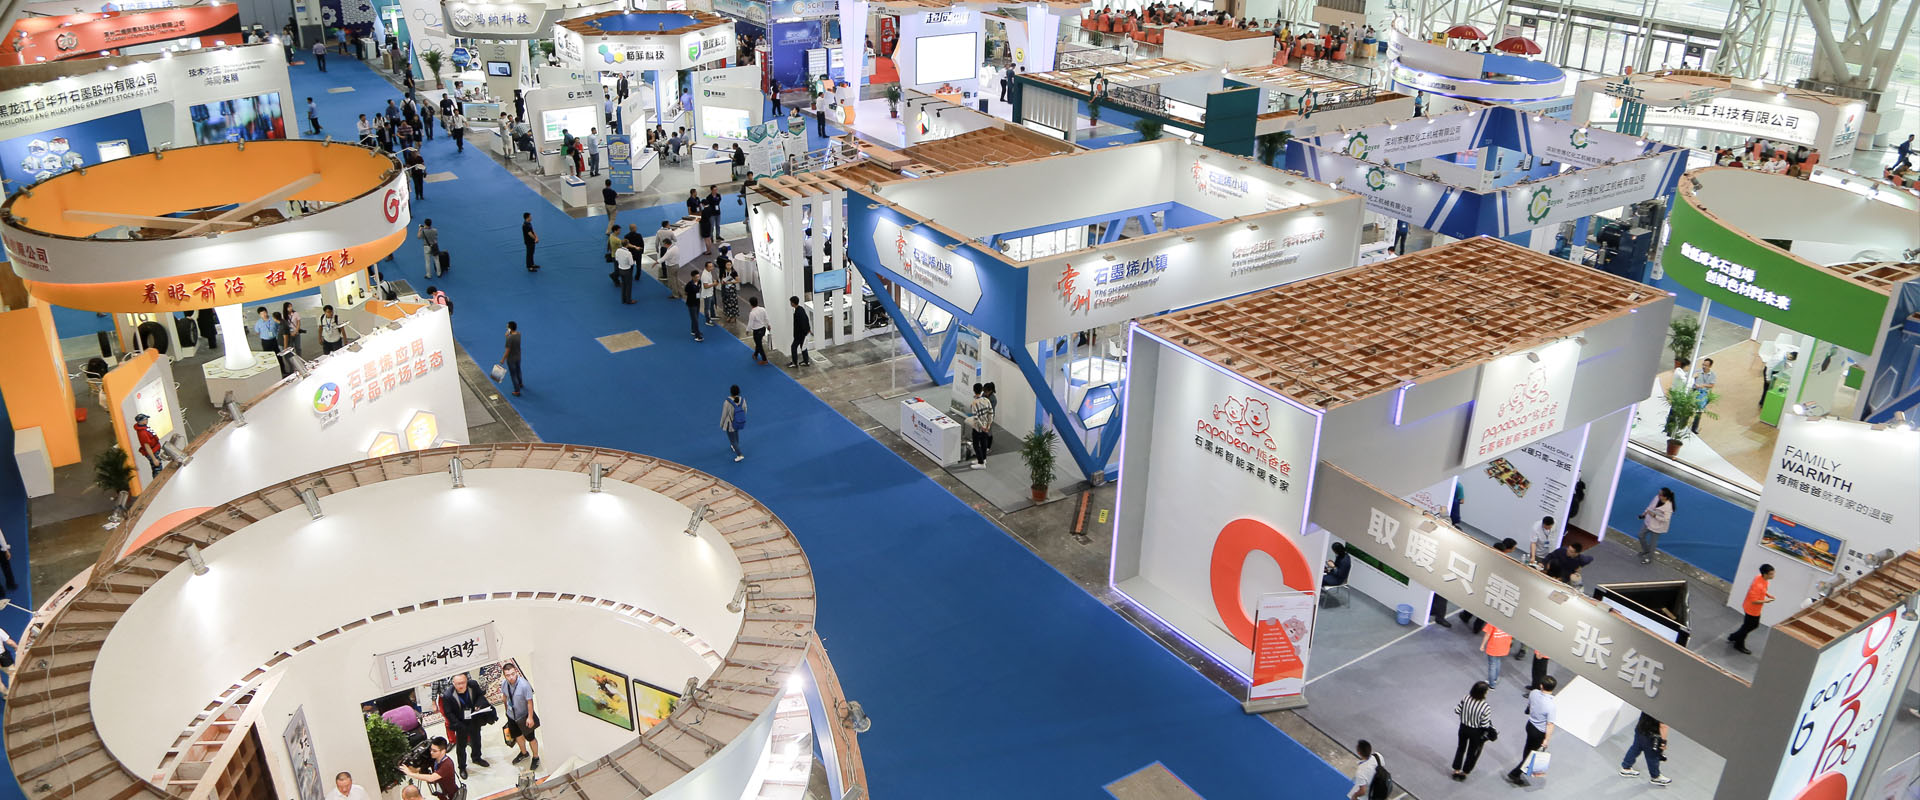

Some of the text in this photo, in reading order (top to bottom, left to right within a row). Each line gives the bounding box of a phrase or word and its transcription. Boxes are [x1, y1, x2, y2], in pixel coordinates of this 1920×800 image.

[1095, 253, 1169, 286] 石墨烯小镇
[347, 337, 426, 390] 石墨烯应用
[351, 350, 444, 410] 产品市场生态
[1194, 434, 1289, 492] 石墨烯智能采暖专家
[1781, 458, 1853, 493] WARMTH
[1785, 445, 1842, 472] FAMILY
[1776, 473, 1894, 524] 有熊爸爸就有家的温暖
[1367, 506, 1665, 698] 取暖只需一张纸
[402, 638, 479, 673] 和谐中国梦
